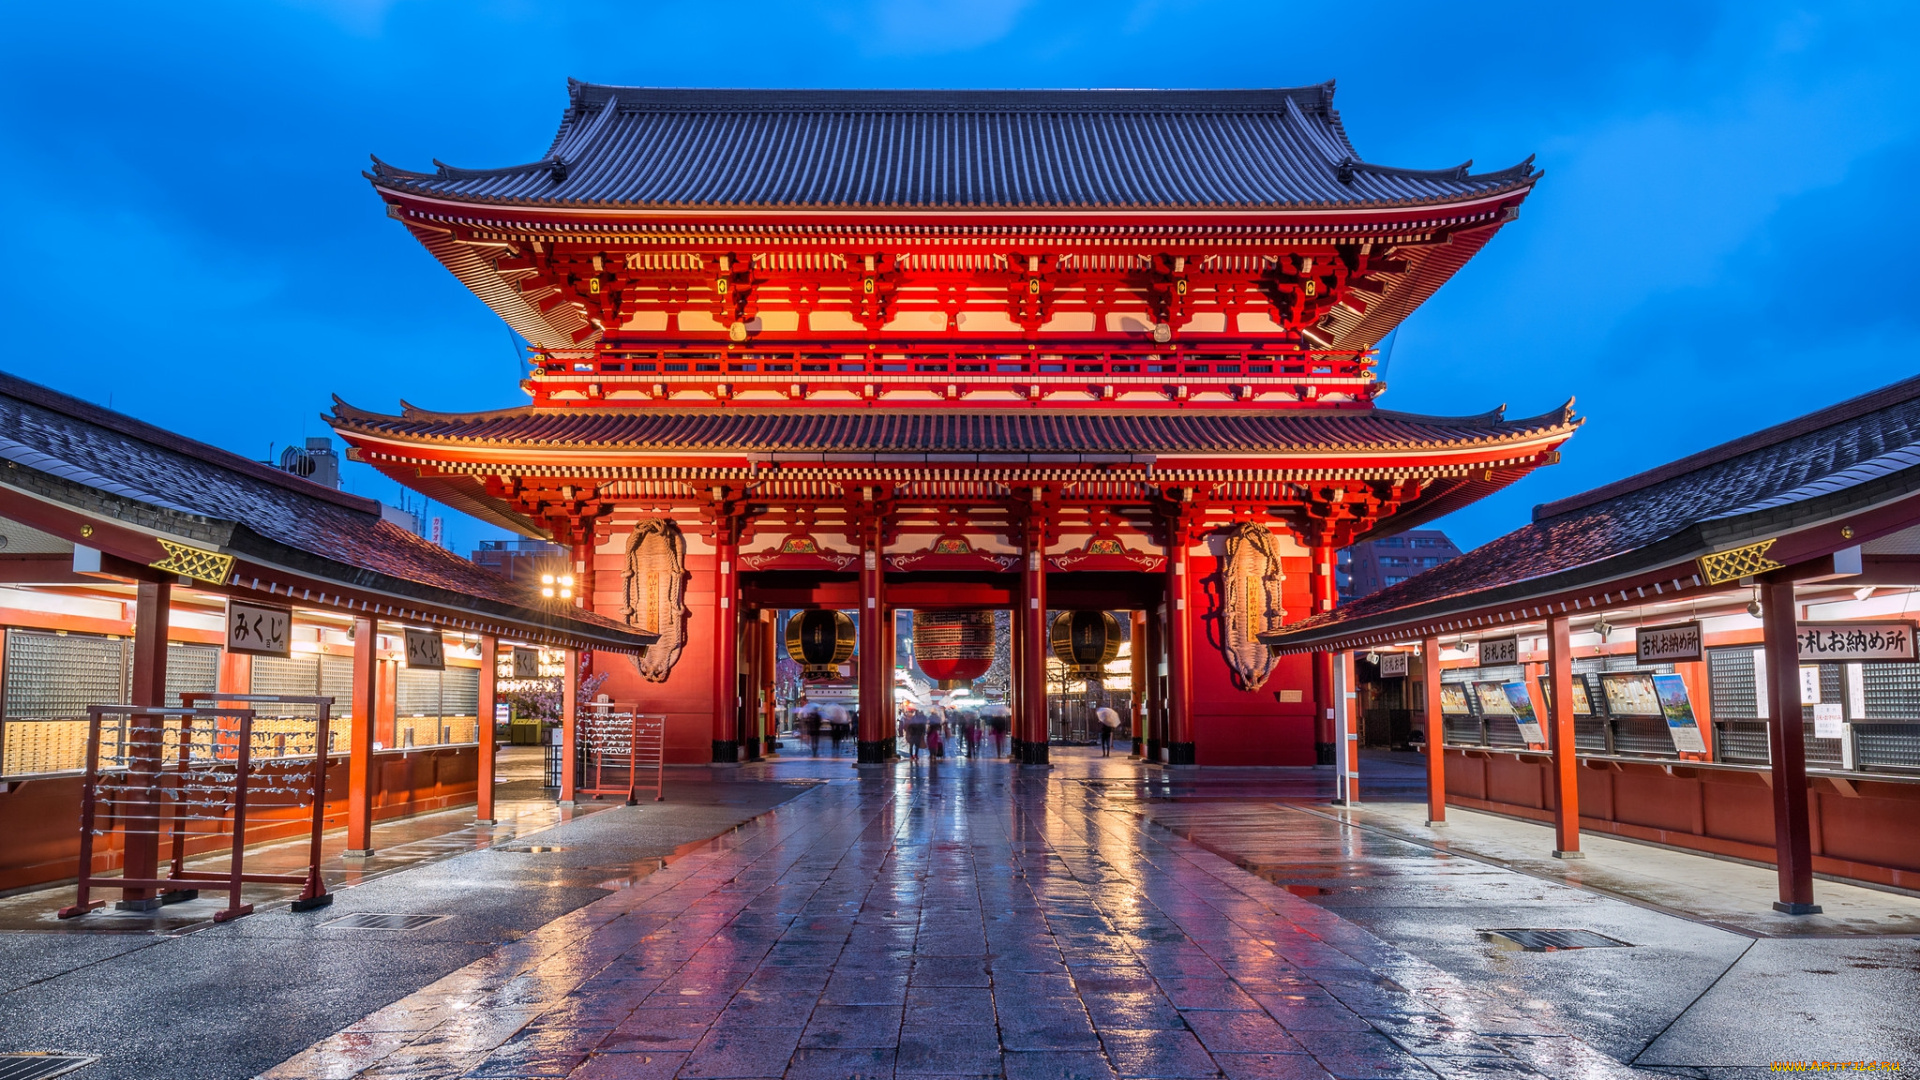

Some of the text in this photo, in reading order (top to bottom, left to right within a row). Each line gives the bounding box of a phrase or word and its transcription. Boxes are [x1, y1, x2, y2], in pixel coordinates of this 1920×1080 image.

[234, 613, 283, 643] みくじ
[410, 637, 438, 659] みくじ
[1484, 641, 1515, 661] お札お守
[1642, 631, 1698, 656] 古札お納め所
